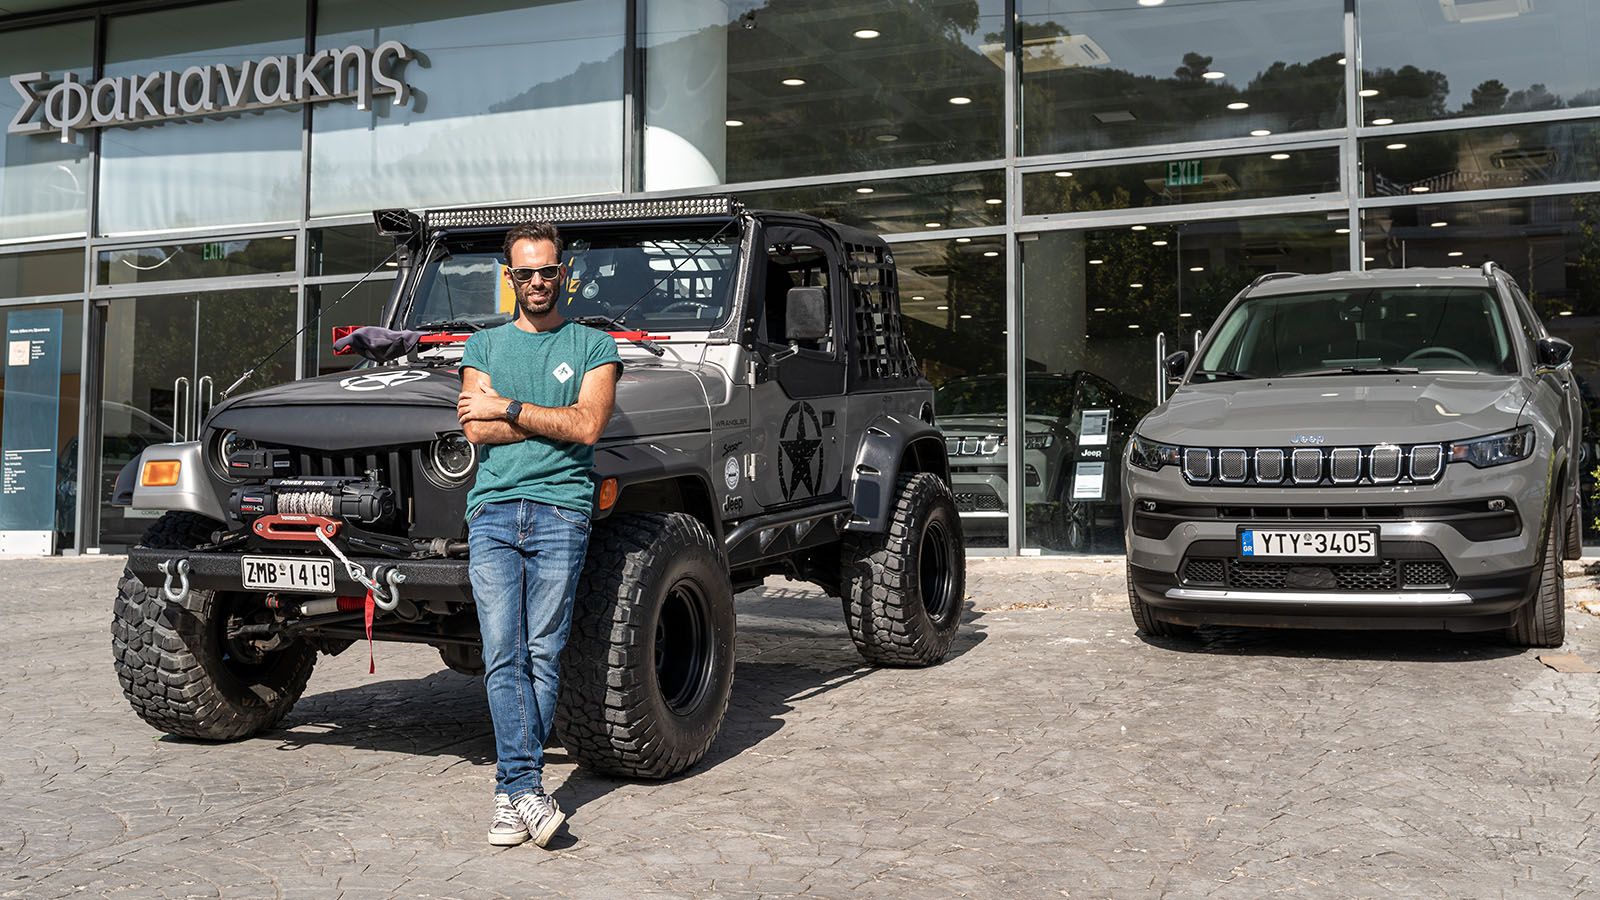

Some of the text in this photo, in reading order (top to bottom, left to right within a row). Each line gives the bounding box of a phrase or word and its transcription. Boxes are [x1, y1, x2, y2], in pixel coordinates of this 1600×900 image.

[8, 40, 409, 143] Σφακιανακης
[1168, 160, 1200, 185] EXIT
[715, 418, 747, 427] WRANGLER
[1290, 432, 1325, 444] Jeep
[1081, 449, 1102, 457] Jeep
[723, 495, 743, 512] Jeep
[1260, 533, 1372, 554] YTY-3405
[246, 562, 330, 586] ZMB-1419
